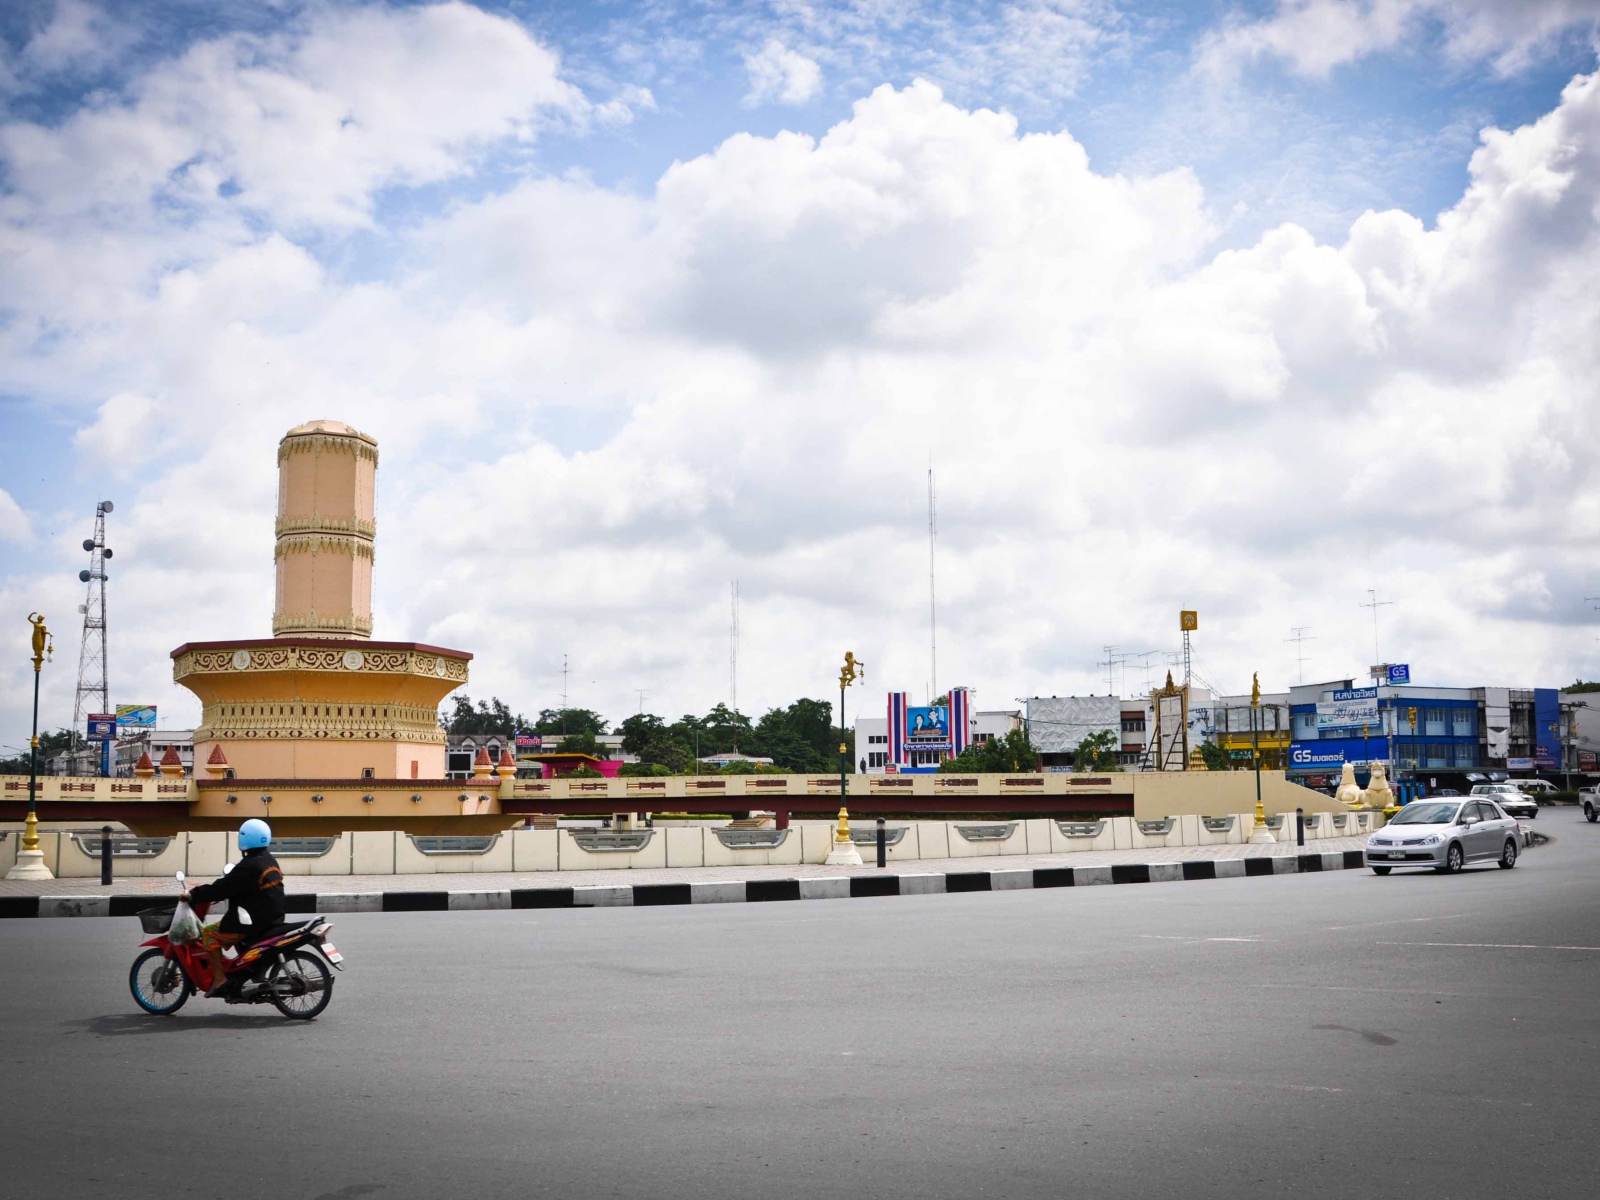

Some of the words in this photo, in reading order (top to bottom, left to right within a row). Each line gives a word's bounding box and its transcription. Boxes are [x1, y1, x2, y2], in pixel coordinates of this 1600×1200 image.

[1392, 666, 1406, 676] GS
[1335, 689, 1376, 700] ส.สง่าอะไหล่
[1293, 750, 1311, 762] GS
[1312, 750, 1344, 762] แบตเตอรี่
